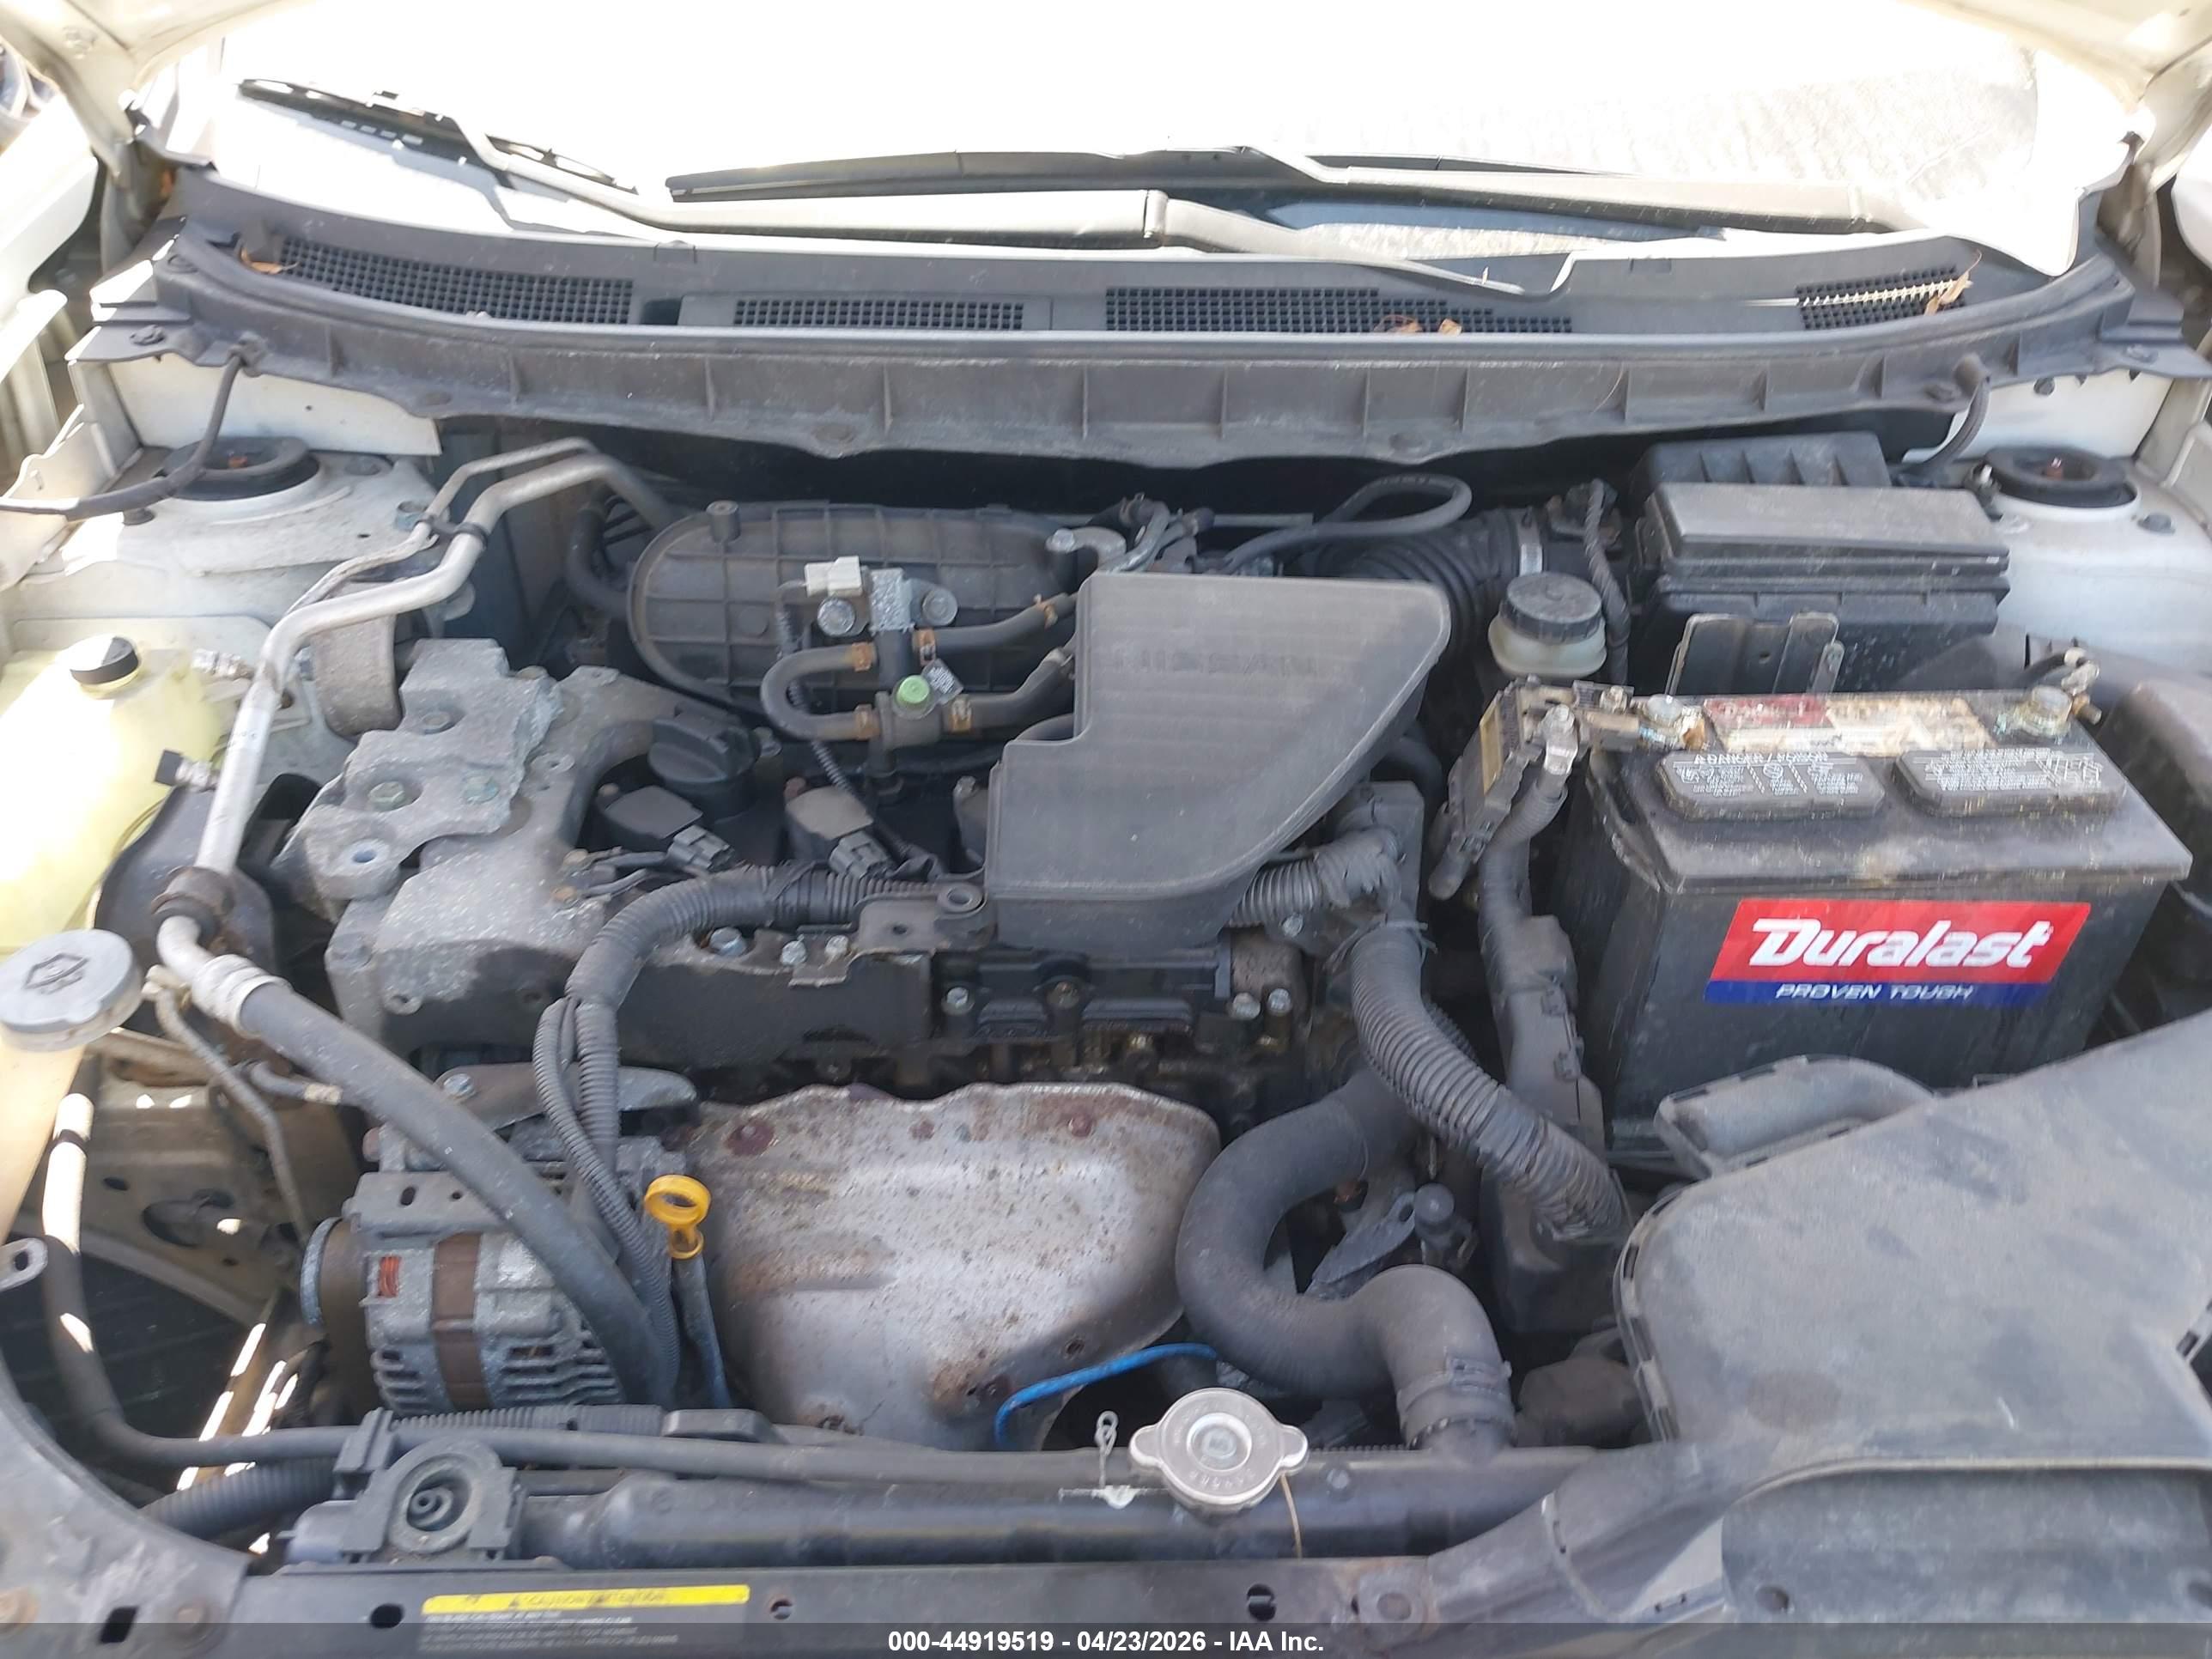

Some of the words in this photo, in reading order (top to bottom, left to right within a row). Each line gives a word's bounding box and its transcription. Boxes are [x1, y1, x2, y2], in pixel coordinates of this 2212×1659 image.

[1749, 918, 2052, 967] Duralast
[1776, 983, 1883, 1000] PROVEN
[1889, 984, 1975, 1000] TOUGH
